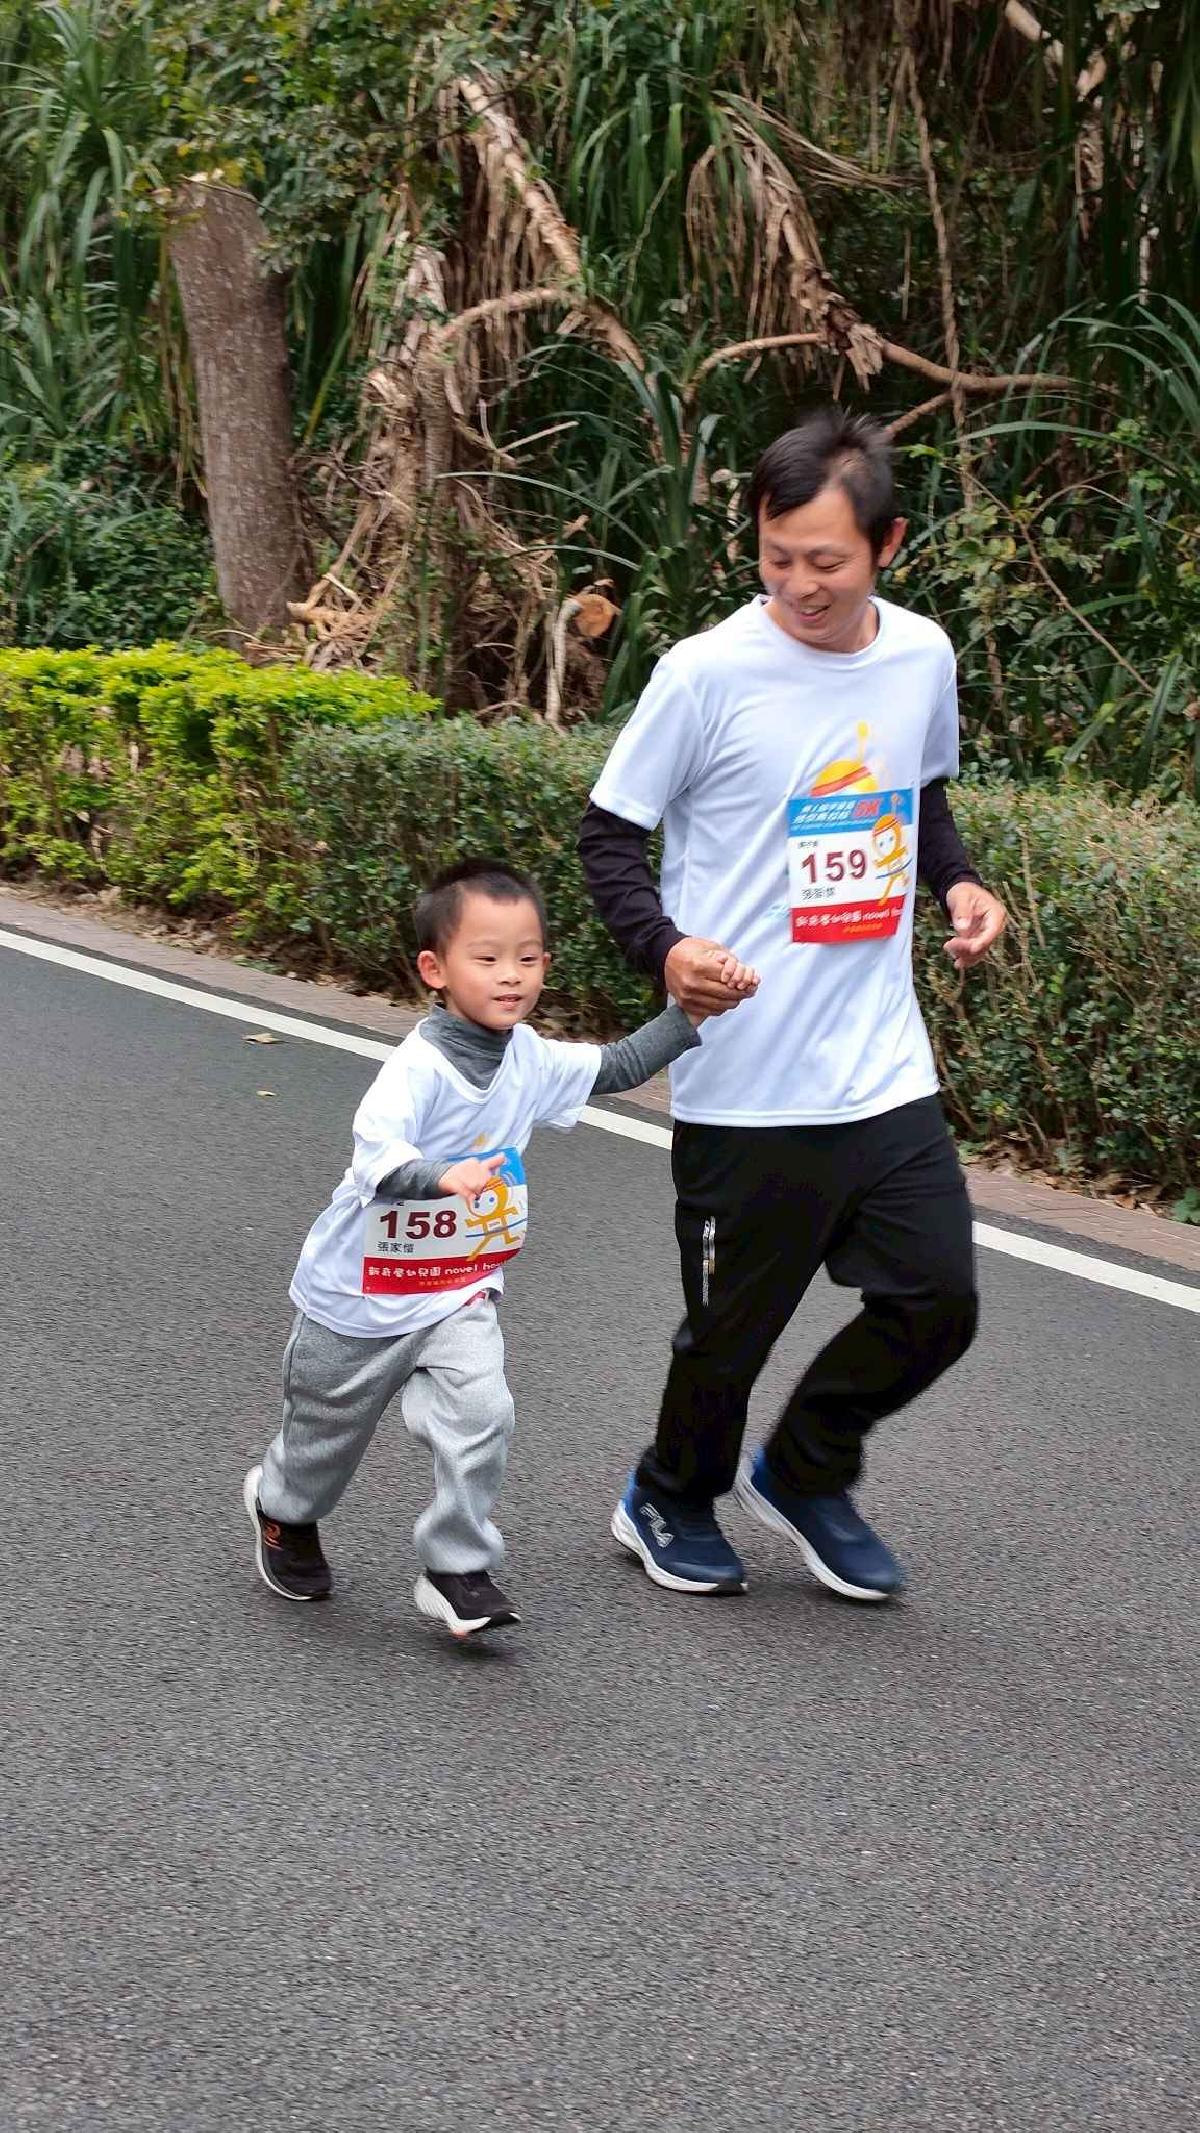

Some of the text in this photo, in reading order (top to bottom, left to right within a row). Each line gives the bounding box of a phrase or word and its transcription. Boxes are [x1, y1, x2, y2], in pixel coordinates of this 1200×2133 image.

[802, 849, 867, 884] 159
[380, 1210, 457, 1239] 158
[444, 1263, 478, 1275] novel
